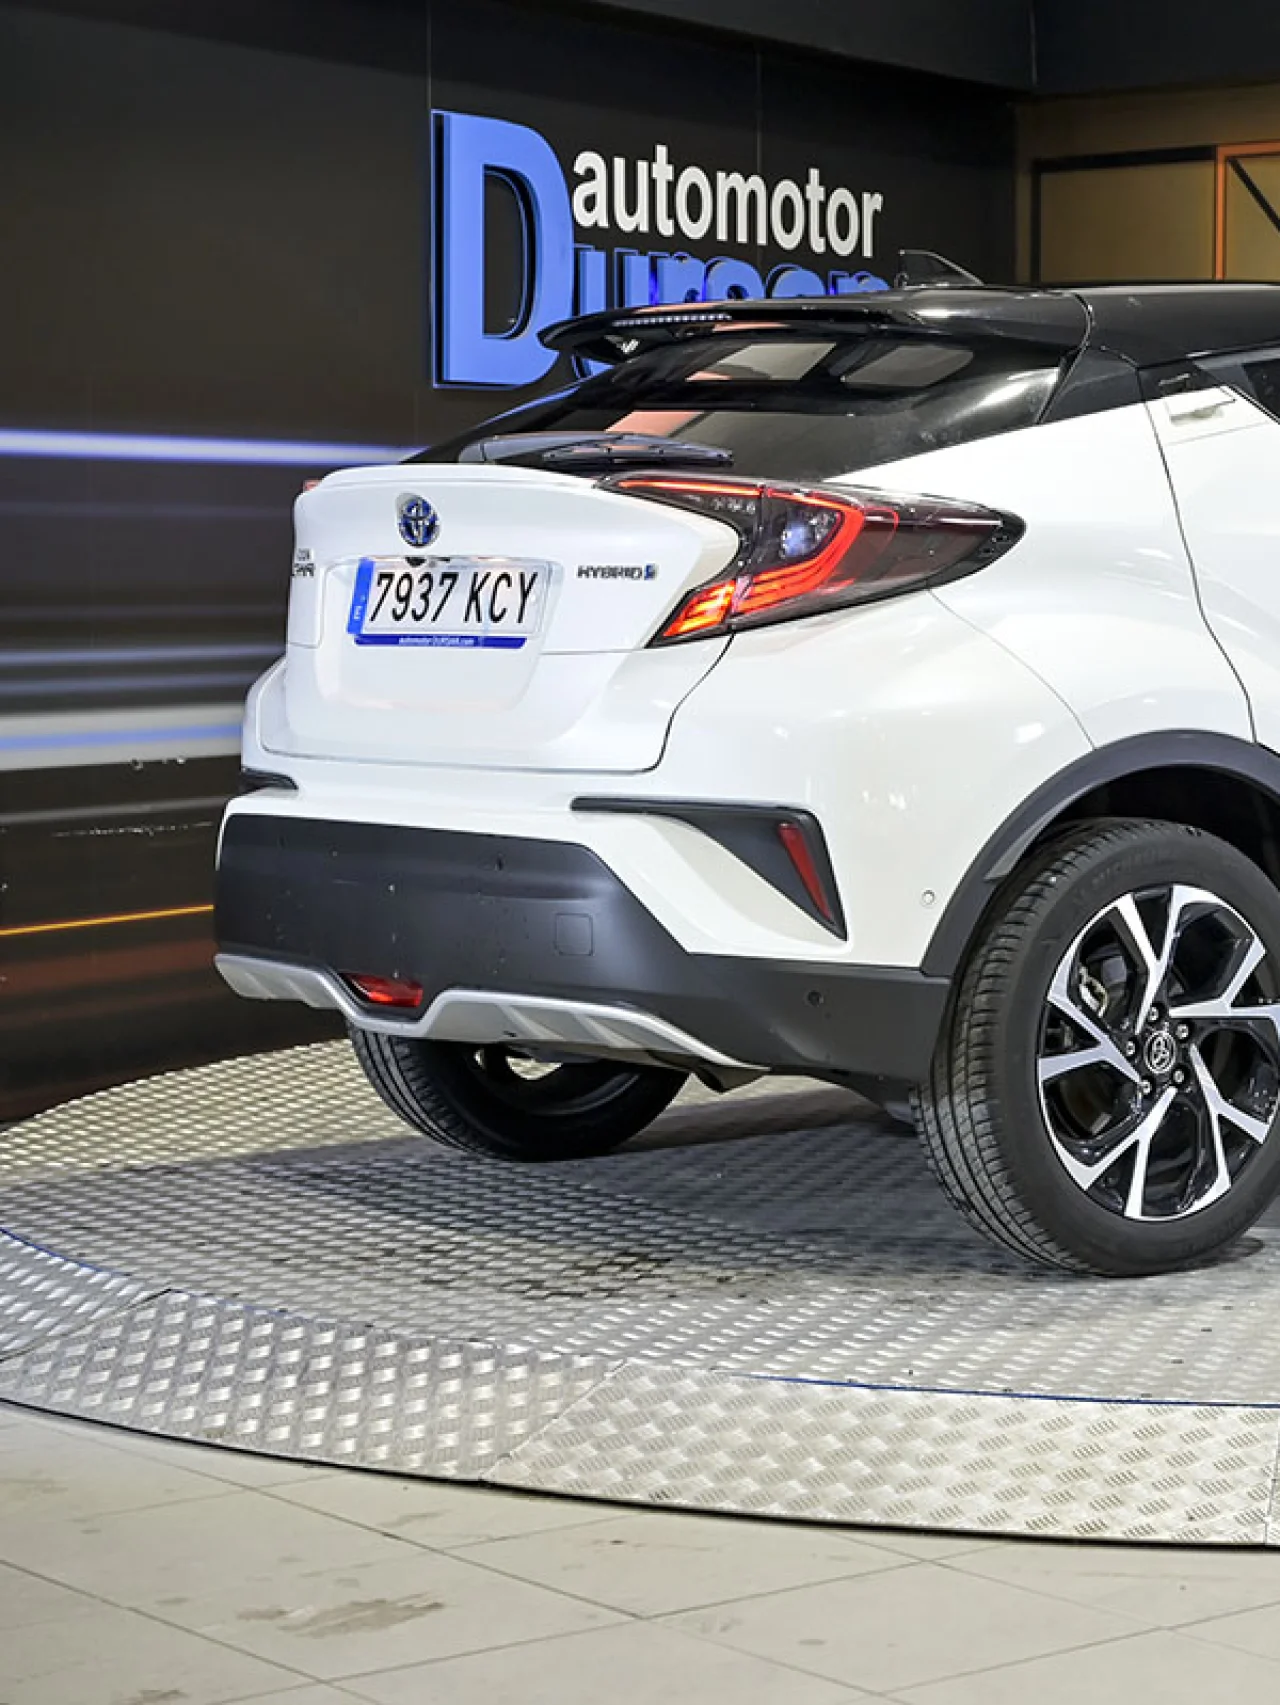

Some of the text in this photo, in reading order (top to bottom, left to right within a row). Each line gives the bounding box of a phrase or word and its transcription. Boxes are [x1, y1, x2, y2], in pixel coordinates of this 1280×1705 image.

[572, 144, 884, 258] automotor
[369, 571, 459, 622] 7937
[463, 571, 538, 624] KCY
